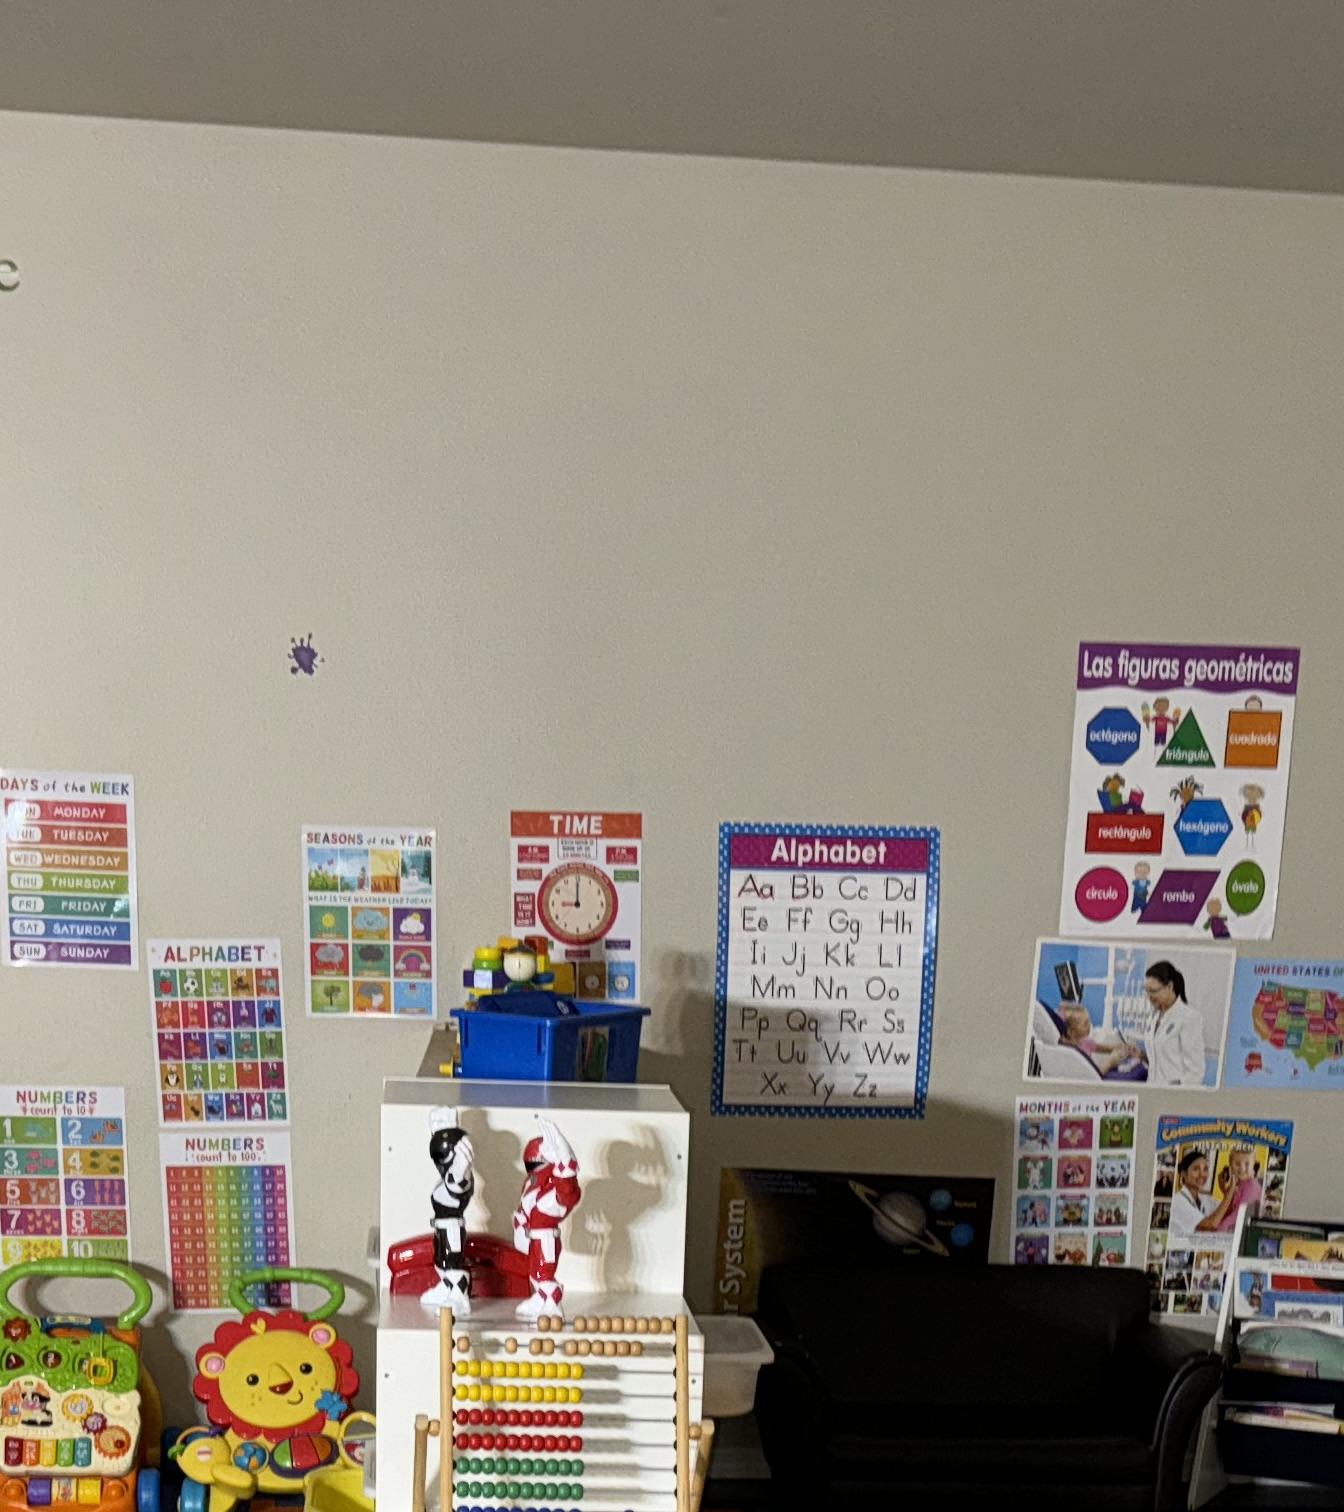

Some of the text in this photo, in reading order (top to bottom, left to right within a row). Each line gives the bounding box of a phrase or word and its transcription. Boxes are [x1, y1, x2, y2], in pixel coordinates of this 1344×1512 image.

[1084, 649, 1294, 686] Las figuras geométricas
[1090, 729, 1137, 744] octágono
[1229, 732, 1276, 746] cuadrado
[1166, 748, 1210, 763] triángulo
[0, 777, 129, 795] DAYS of the WEEK
[54, 806, 106, 818] MONDAY
[549, 815, 603, 835] TIME
[1179, 820, 1229, 834] hexágono
[52, 830, 109, 842] TUESDAY
[306, 832, 363, 845] SEASONS
[400, 834, 432, 847] YEAR
[1098, 826, 1152, 841] rectángulo
[771, 838, 887, 866] Alphabet
[14, 854, 120, 866] WED WEDNESDAY
[16, 877, 116, 889] THU THURSDAY
[738, 874, 916, 901] Aa Bb Cc Dd
[1232, 881, 1259, 893] óvalo
[1086, 888, 1118, 900] círculo
[1162, 890, 1195, 903] rombo
[18, 900, 106, 912] FRI FRIDAY
[18, 922, 117, 936] SAT SATURDAY
[742, 906, 912, 944] Ee Ff Gg Hh
[18, 946, 109, 958] SUN SUNDAY
[164, 945, 265, 963] ALPHABET
[782, 942, 806, 977] Jj
[826, 942, 856, 967] Kk
[1254, 964, 1289, 976] UNITED
[1292, 965, 1330, 977] STATES
[1333, 967, 1344, 977] OF
[752, 974, 900, 1000] Mm Nn Oo
[742, 1007, 904, 1042] Pp Qq Rr Ss
[732, 1039, 910, 1065] Tt Uu Vv Ww
[760, 1072, 877, 1106] Xx Yy Zz
[16, 1090, 98, 1104] NUMBERS
[62, 1104, 73, 1115] to
[76, 1104, 86, 1115] 10
[1019, 1101, 1070, 1113] MONTHS
[1104, 1100, 1135, 1112] YEAR
[1162, 1120, 1236, 1142] Community
[1236, 1121, 1288, 1146] Workers
[185, 1137, 265, 1151] NUMBERS
[196, 1151, 256, 1162] count to 100
[720, 1199, 746, 1295] System
